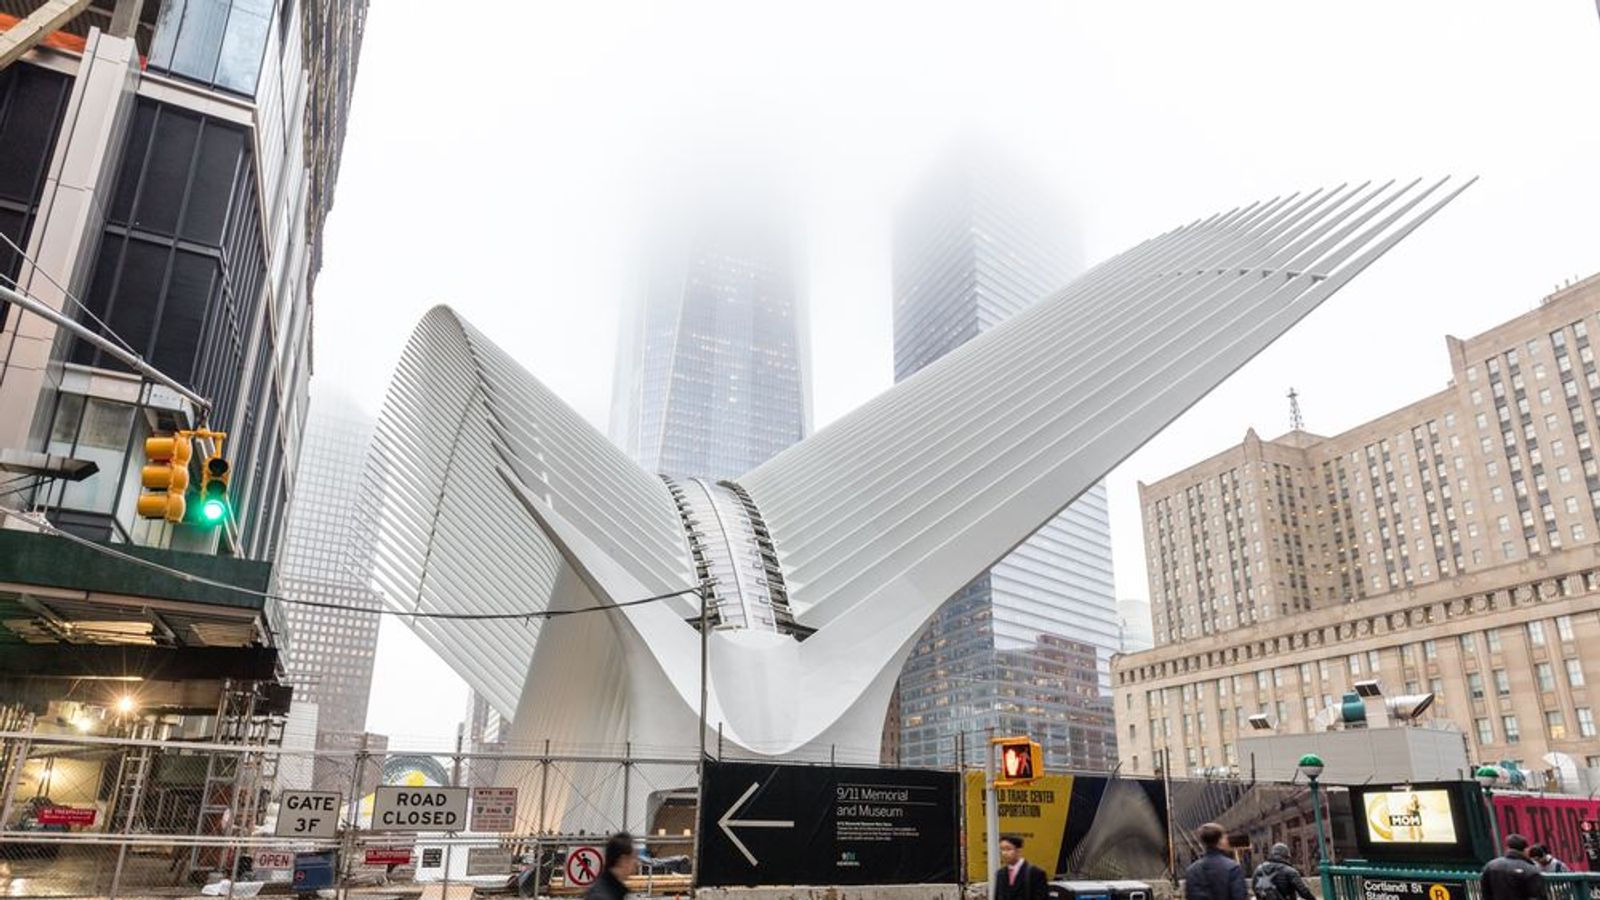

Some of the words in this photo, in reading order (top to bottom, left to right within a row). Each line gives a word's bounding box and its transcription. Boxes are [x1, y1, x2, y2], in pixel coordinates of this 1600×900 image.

[396, 793, 447, 806] ROAD
[836, 786, 859, 800] 9/11
[861, 788, 909, 801] Memorial
[1008, 789, 1028, 803] TRADE
[1030, 790, 1054, 804] CENTER
[286, 796, 335, 812] GATE
[836, 804, 857, 816] and
[859, 805, 904, 817] Museum
[294, 818, 321, 833] 3F
[382, 811, 457, 826] CLOSED
[1392, 815, 1421, 826] MOM
[259, 854, 290, 867] OPEN
[1363, 880, 1409, 893] Cortlandt
[1410, 882, 1424, 894] St
[1365, 890, 1400, 900] Station
